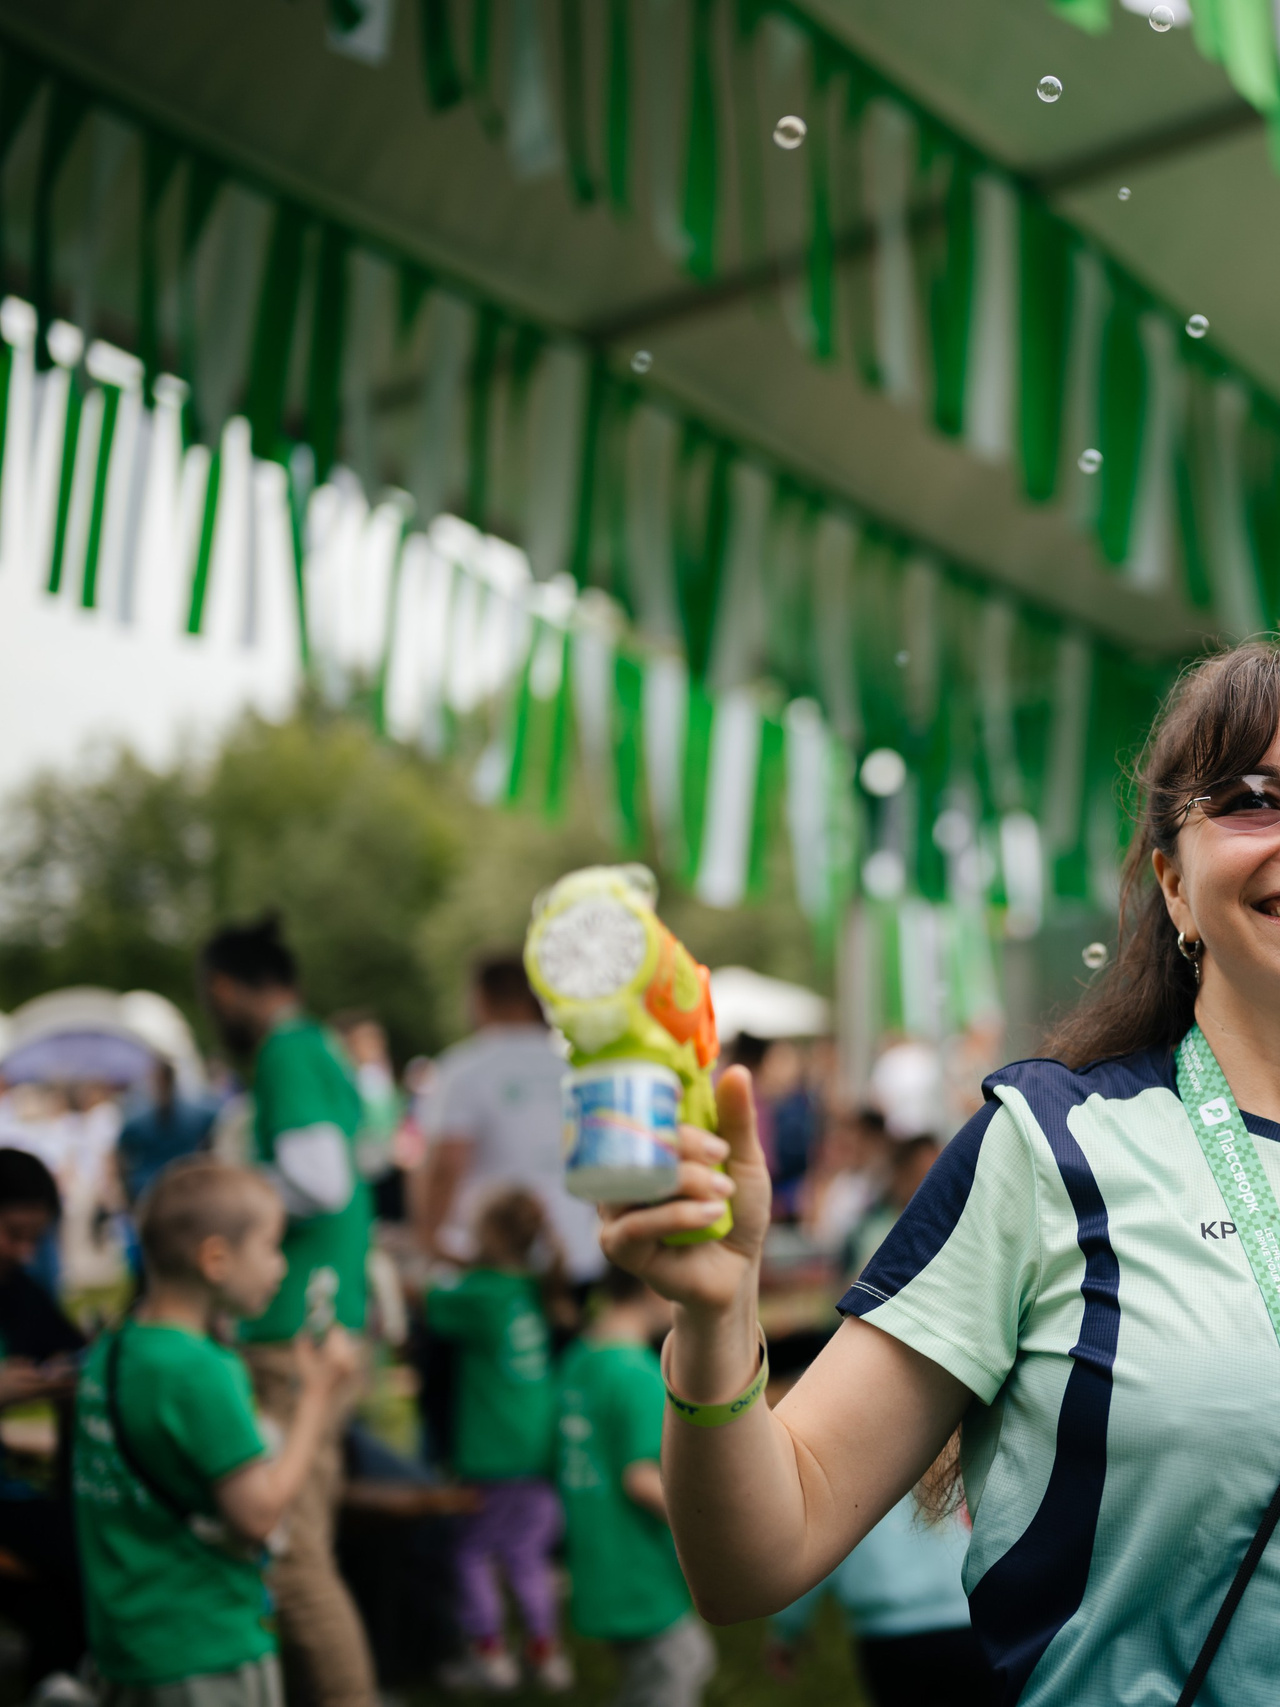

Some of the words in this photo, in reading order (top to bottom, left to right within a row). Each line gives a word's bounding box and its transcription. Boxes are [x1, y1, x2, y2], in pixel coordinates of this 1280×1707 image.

[1189, 1070, 1203, 1093] WORK
[1216, 1129, 1260, 1215] Пассворк
[1264, 1227, 1276, 1243] LET
[1255, 1229, 1271, 1257] DRIVE
[1266, 1257, 1280, 1283] YOUR
